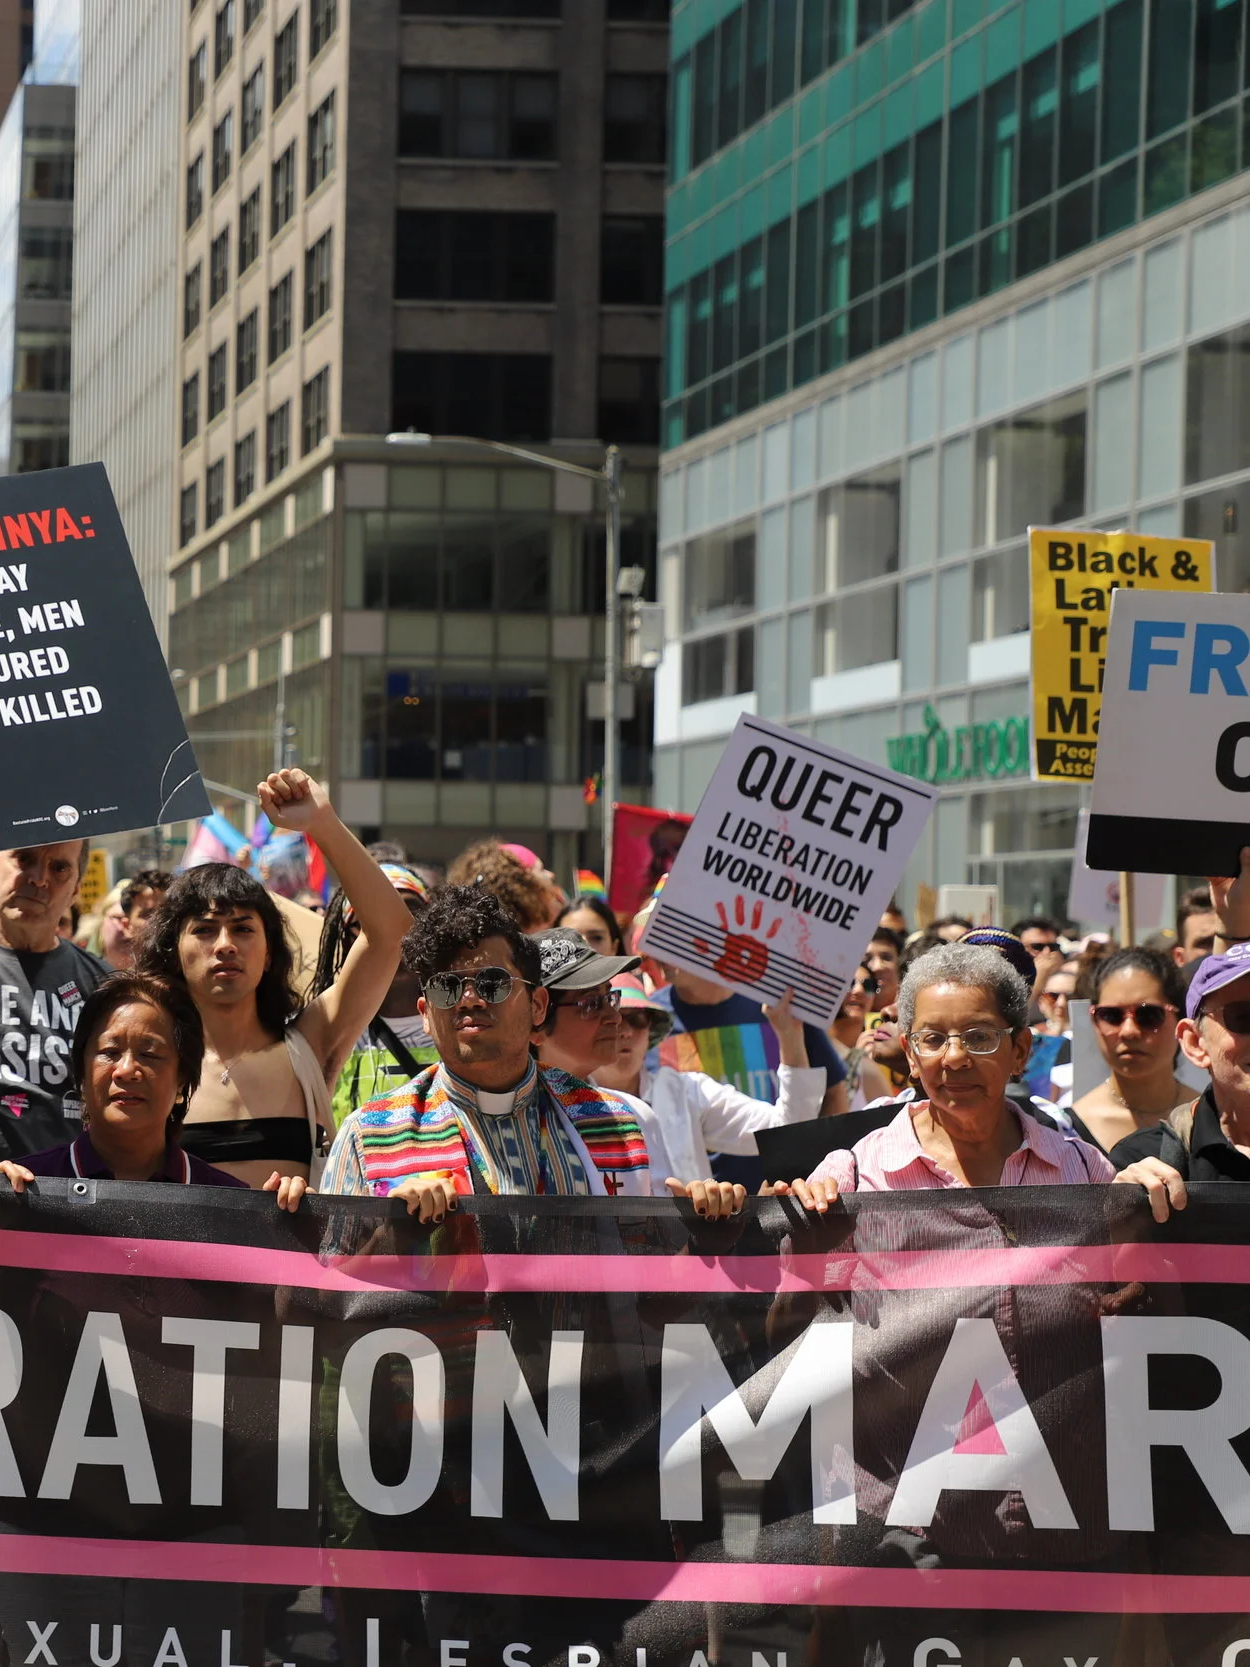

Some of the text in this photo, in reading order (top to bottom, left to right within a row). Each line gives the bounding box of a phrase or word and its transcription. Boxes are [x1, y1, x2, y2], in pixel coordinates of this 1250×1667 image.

[1047, 541, 1200, 582] Black &
[17, 599, 86, 634] MEN
[736, 745, 904, 852] QUEER
[702, 845, 861, 931] WORLDWIDE
[716, 812, 874, 895] LIBERATION
[658, 1315, 1250, 1536] MAR
